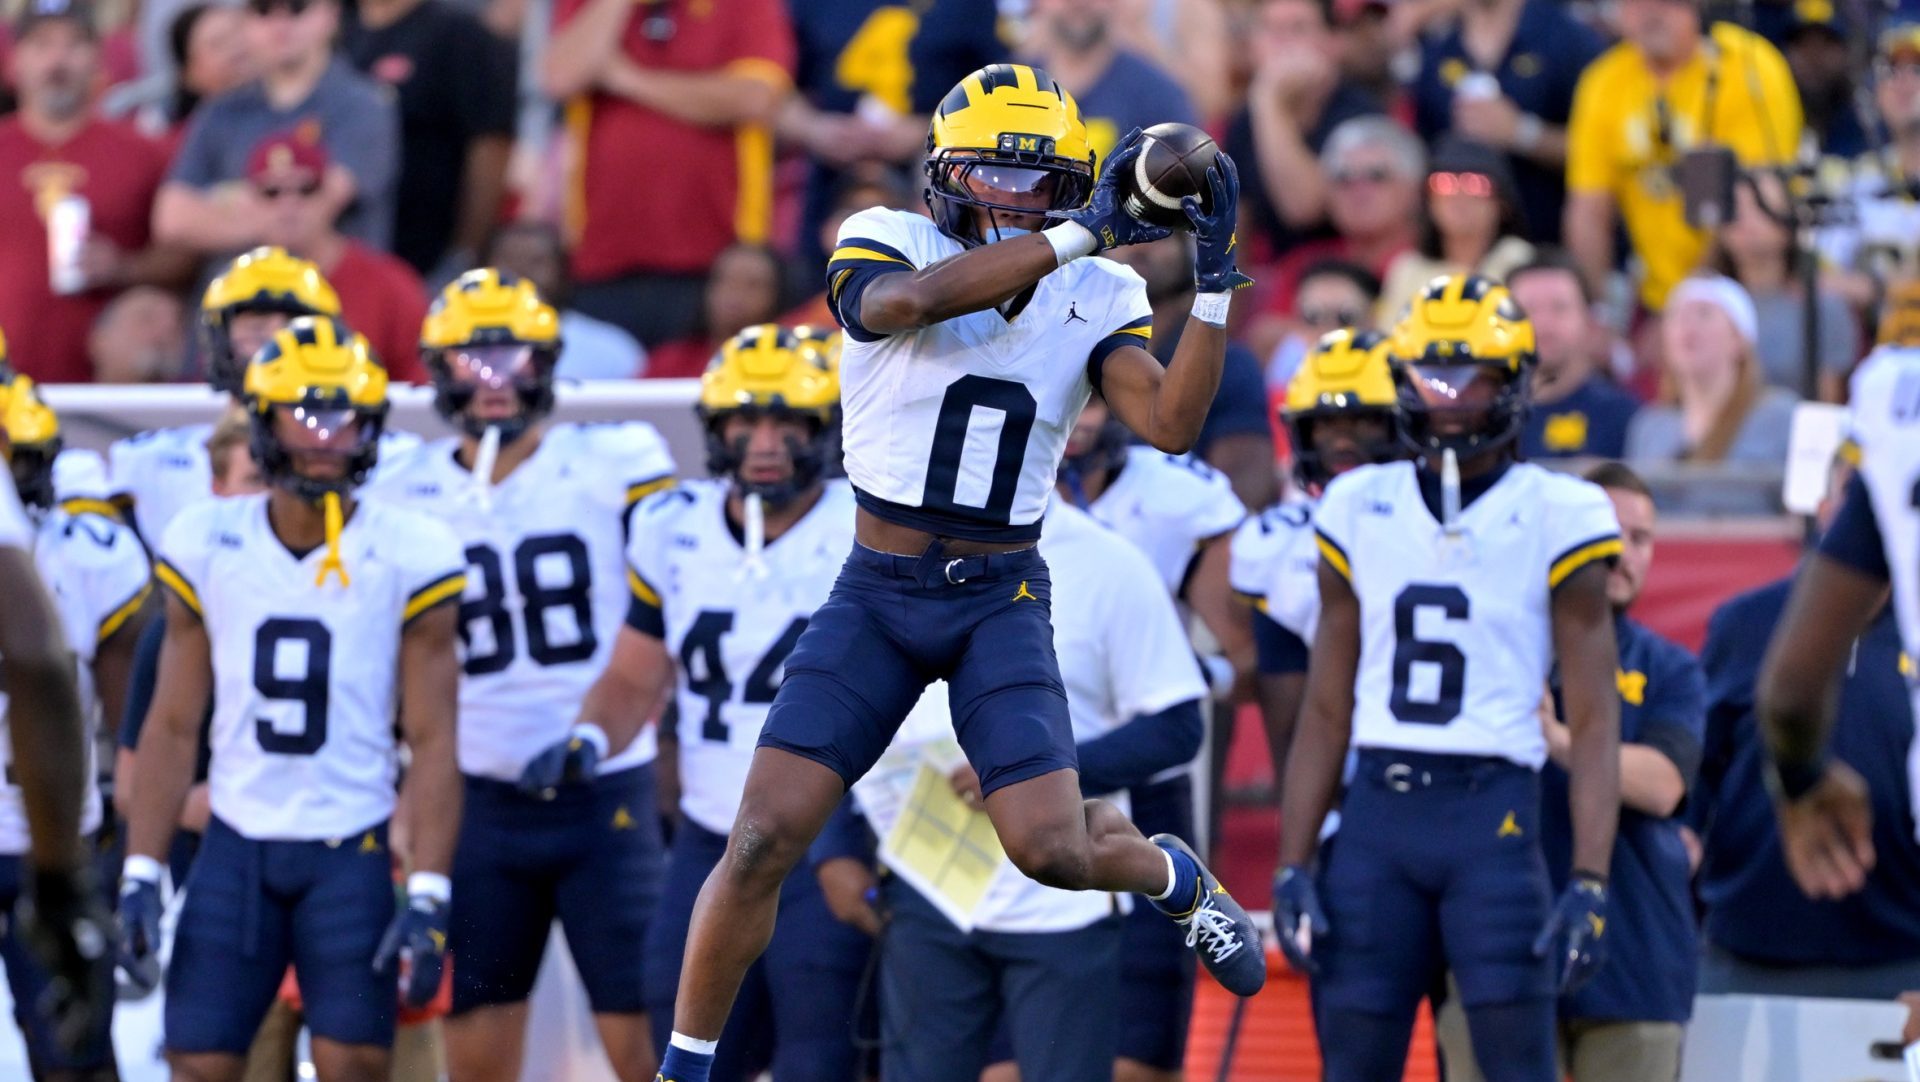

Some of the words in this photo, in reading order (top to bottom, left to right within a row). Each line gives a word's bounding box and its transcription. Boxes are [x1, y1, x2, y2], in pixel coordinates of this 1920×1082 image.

[1018, 137, 1037, 151] M
[921, 373, 1037, 526] 0
[457, 533, 598, 676] 88
[1389, 583, 1470, 727] 6
[253, 617, 333, 756] 9
